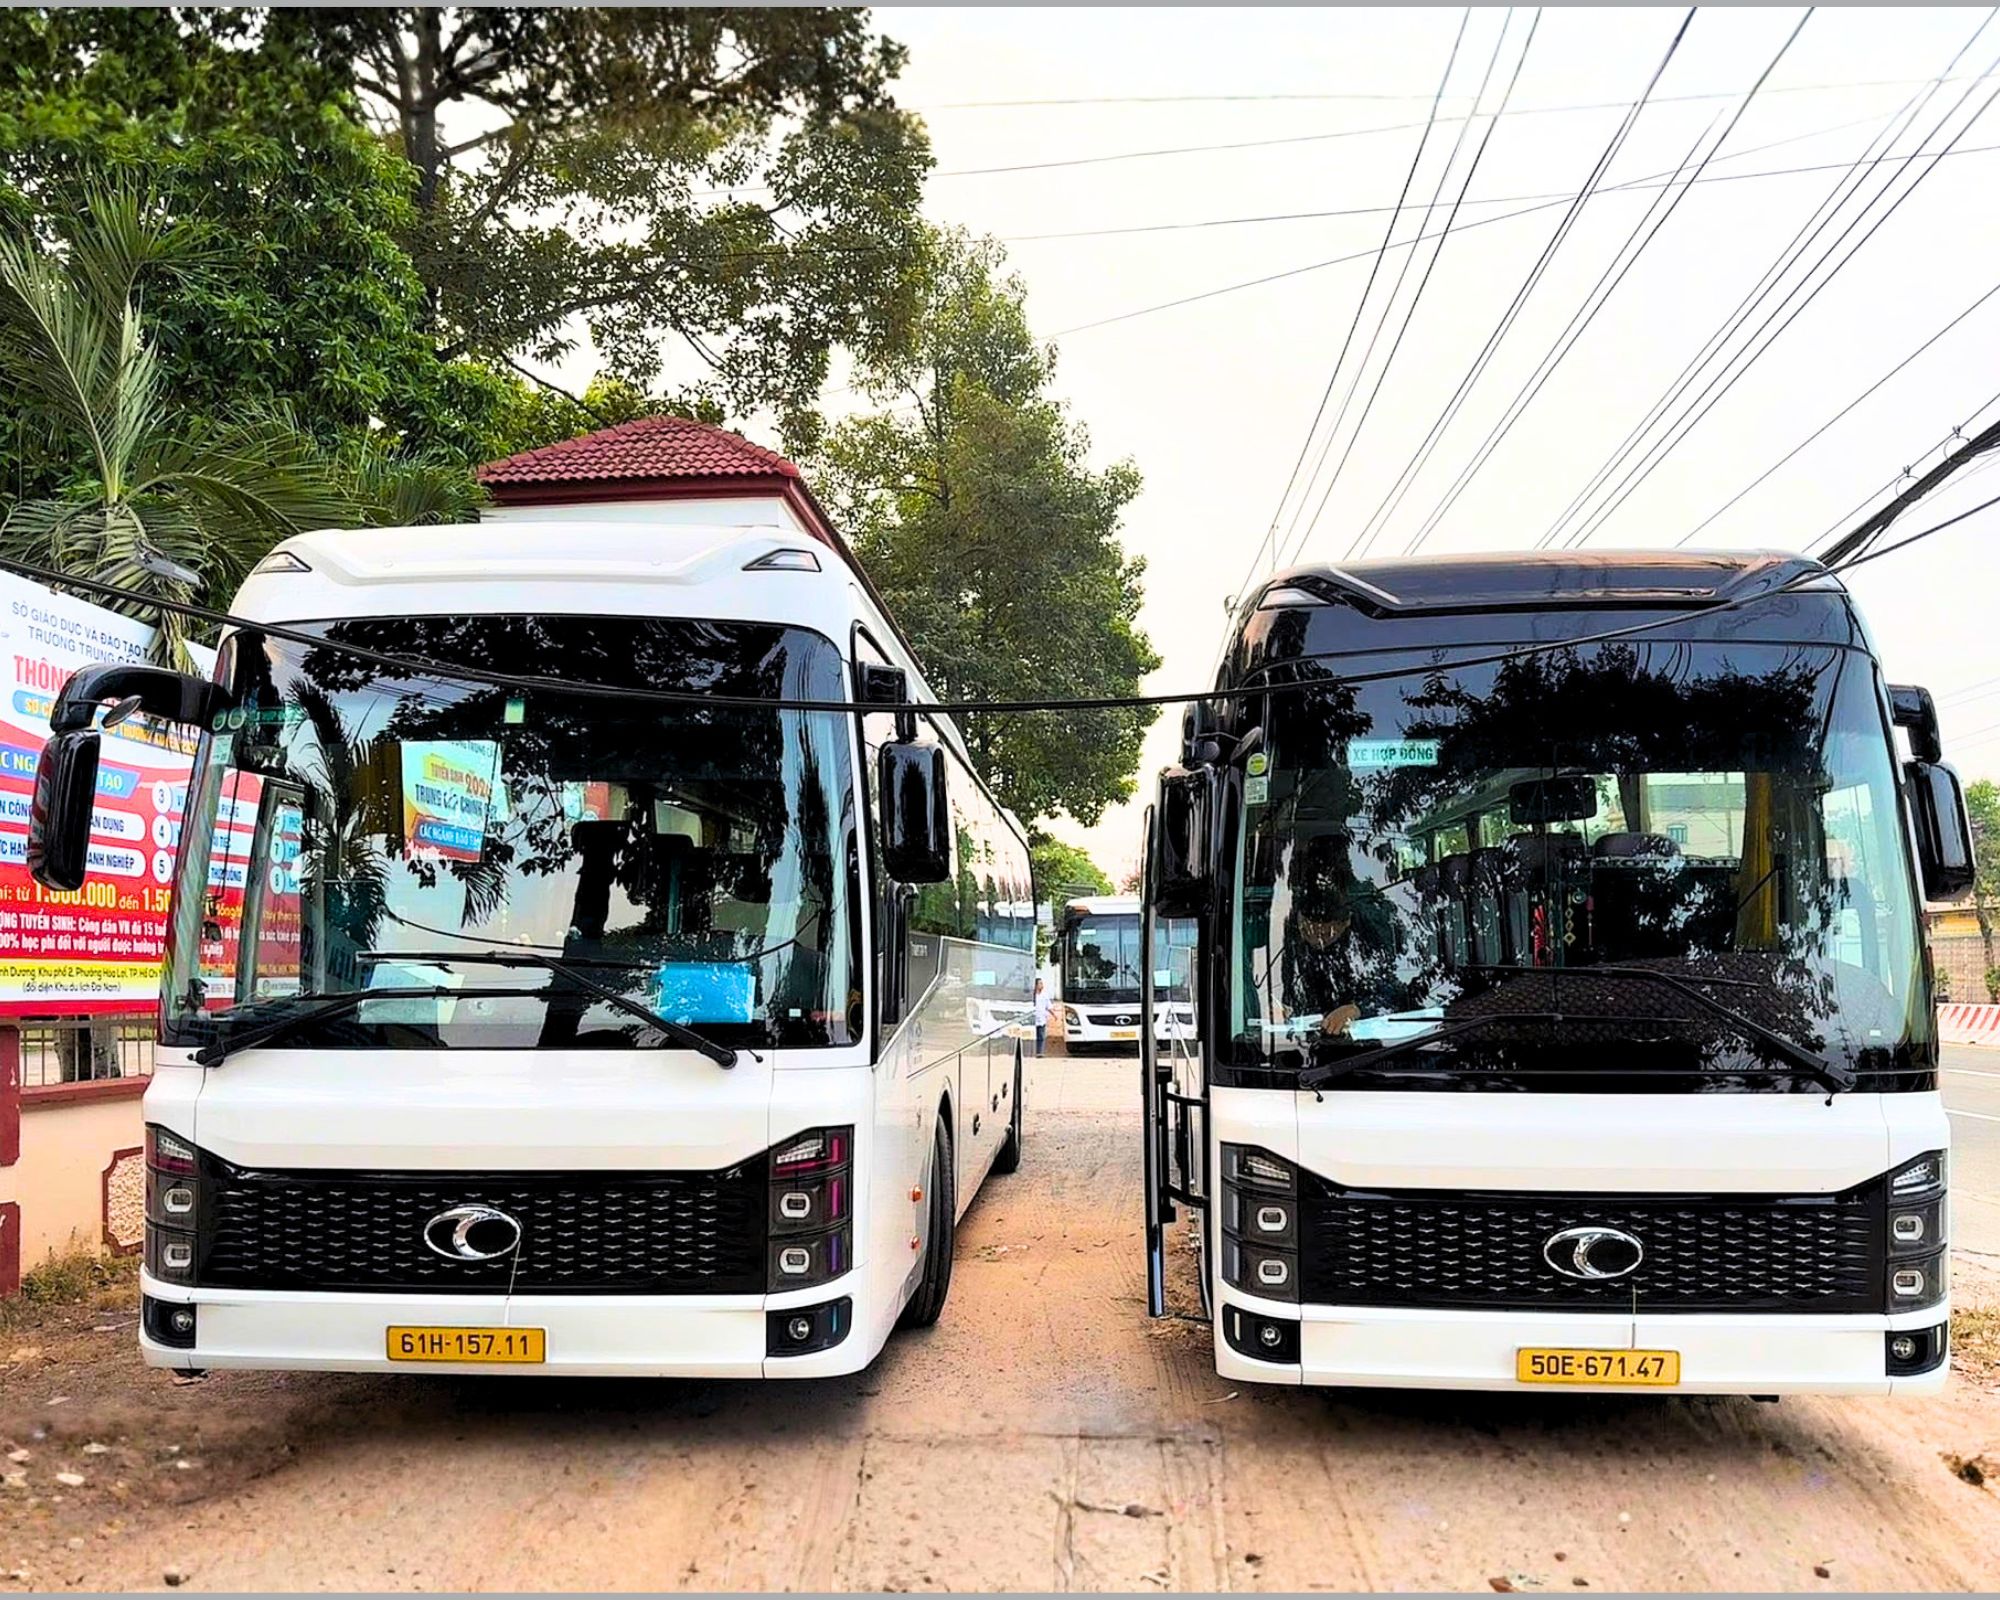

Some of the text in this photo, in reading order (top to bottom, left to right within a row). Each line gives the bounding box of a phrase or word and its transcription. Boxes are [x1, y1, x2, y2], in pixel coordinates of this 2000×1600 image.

[31, 608, 58, 627] GIÁO
[1353, 740, 1434, 765] XE HỢP ĐỒNG
[158, 788, 165, 804] 3
[159, 825, 165, 838] 4
[158, 859, 165, 874] 5
[119, 894, 140, 910] đến
[19, 908, 51, 930] TUYỂN
[51, 916, 77, 932] SINH:
[78, 917, 101, 936] Công
[144, 922, 154, 936] 15
[21, 933, 40, 952] học
[41, 934, 56, 953] phí
[401, 1332, 529, 1356] 61H-157.11
[1531, 1354, 1665, 1378] 50E-671.47
